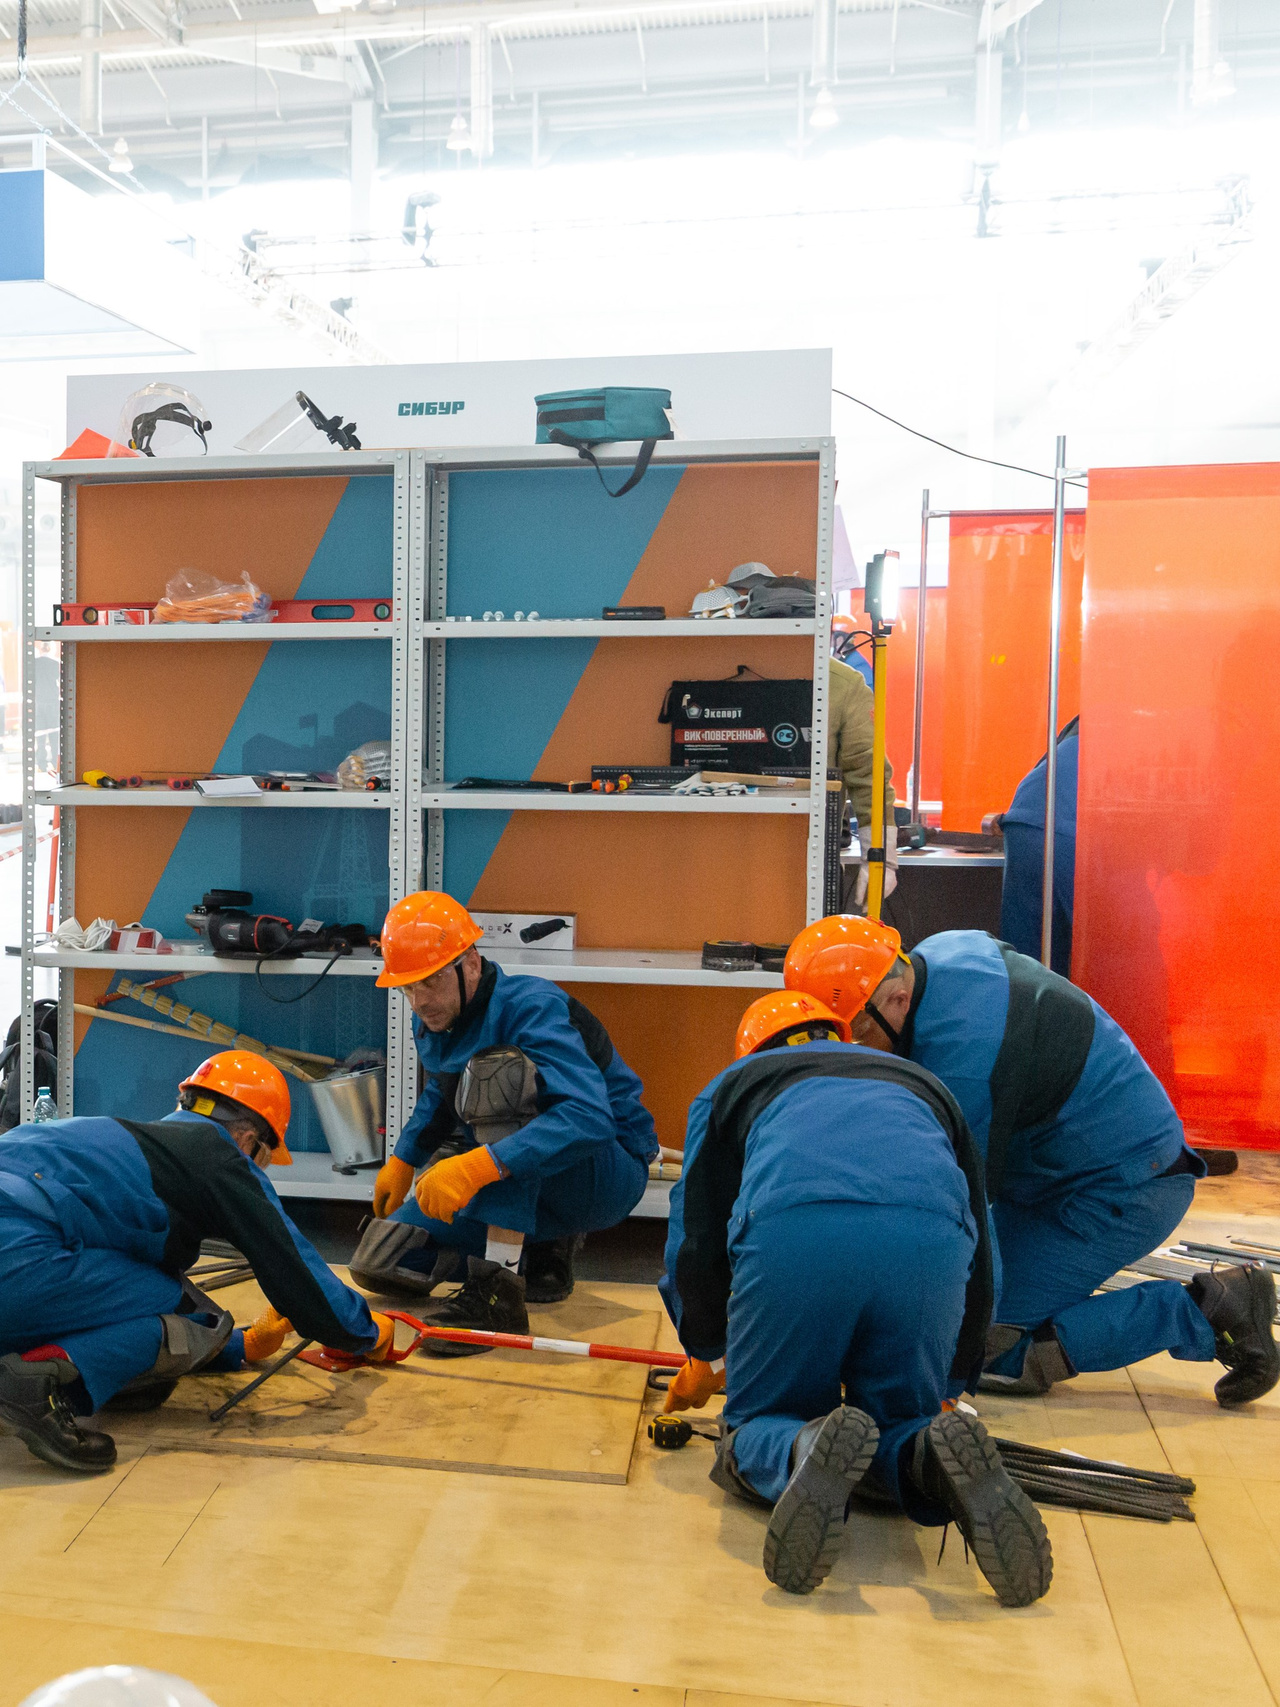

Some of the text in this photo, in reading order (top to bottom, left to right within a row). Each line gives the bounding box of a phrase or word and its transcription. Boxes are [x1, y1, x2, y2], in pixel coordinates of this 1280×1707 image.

[397, 401, 465, 416] СИБУР
[704, 708, 742, 719] Эксперт
[684, 730, 701, 741] ВИК
